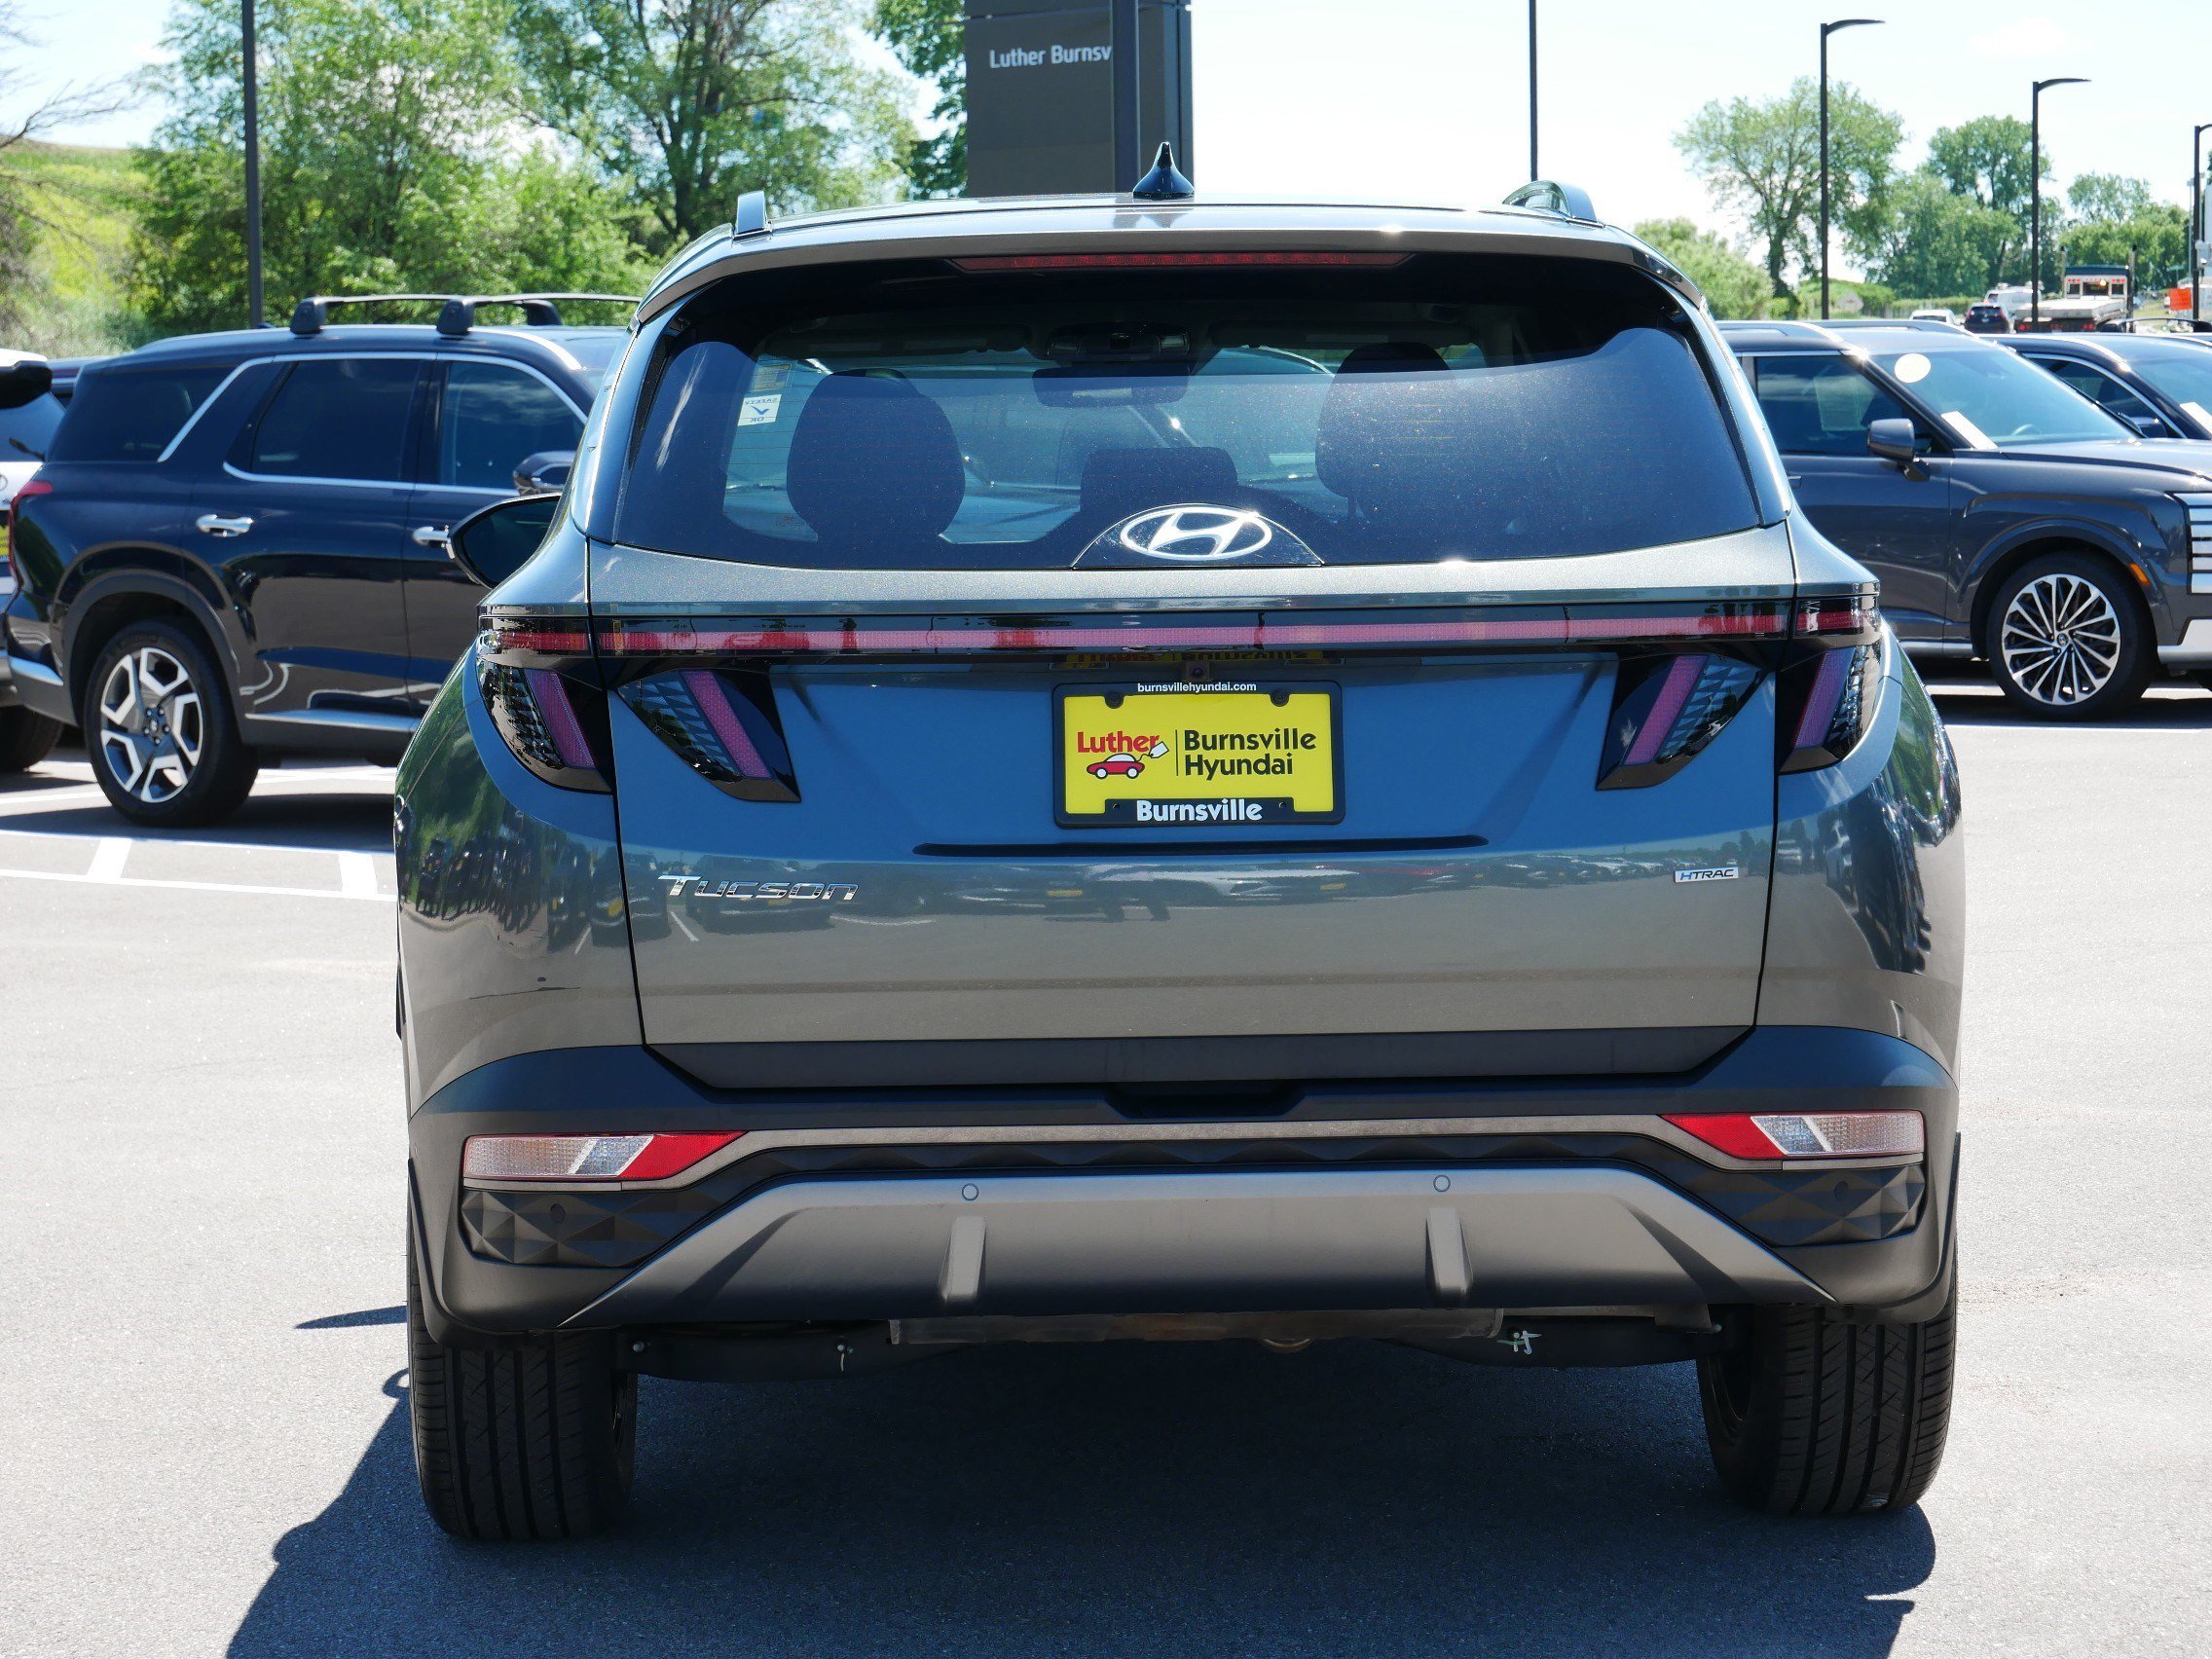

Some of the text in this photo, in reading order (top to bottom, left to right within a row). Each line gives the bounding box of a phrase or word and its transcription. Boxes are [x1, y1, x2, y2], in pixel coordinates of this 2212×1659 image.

[989, 48, 1046, 68] Luther
[1137, 682, 1257, 693] burnsvillehyundai.com
[1077, 731, 1160, 754] Luther
[1184, 727, 1316, 751] Burnsville
[1185, 752, 1293, 781] Hyundai
[1136, 798, 1263, 822] Burnsville
[1679, 868, 1735, 881] HTRAC
